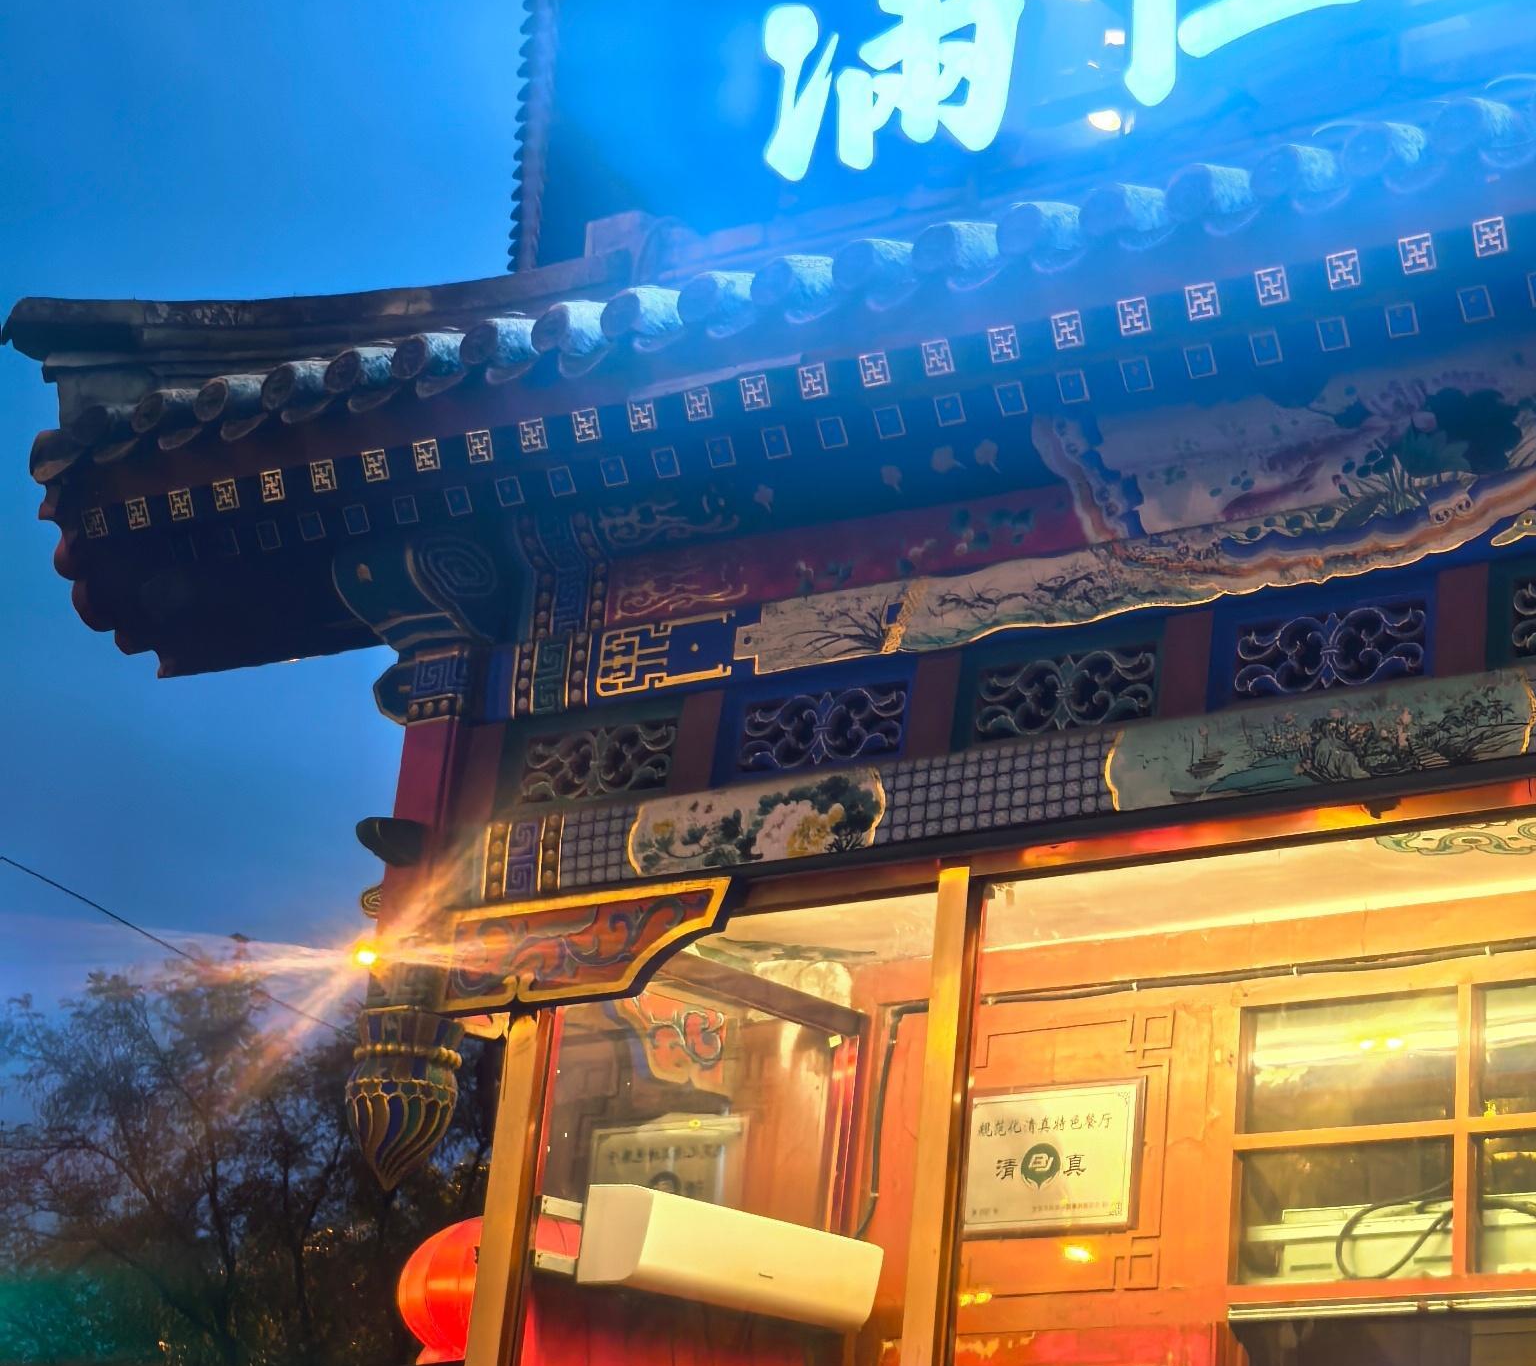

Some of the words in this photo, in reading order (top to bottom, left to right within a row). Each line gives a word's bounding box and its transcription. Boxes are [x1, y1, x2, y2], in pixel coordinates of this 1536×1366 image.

[977, 1112, 1114, 1138] 规范化清真特色餐厅
[995, 1159, 1019, 1180] 清
[1063, 1153, 1087, 1177] 真
